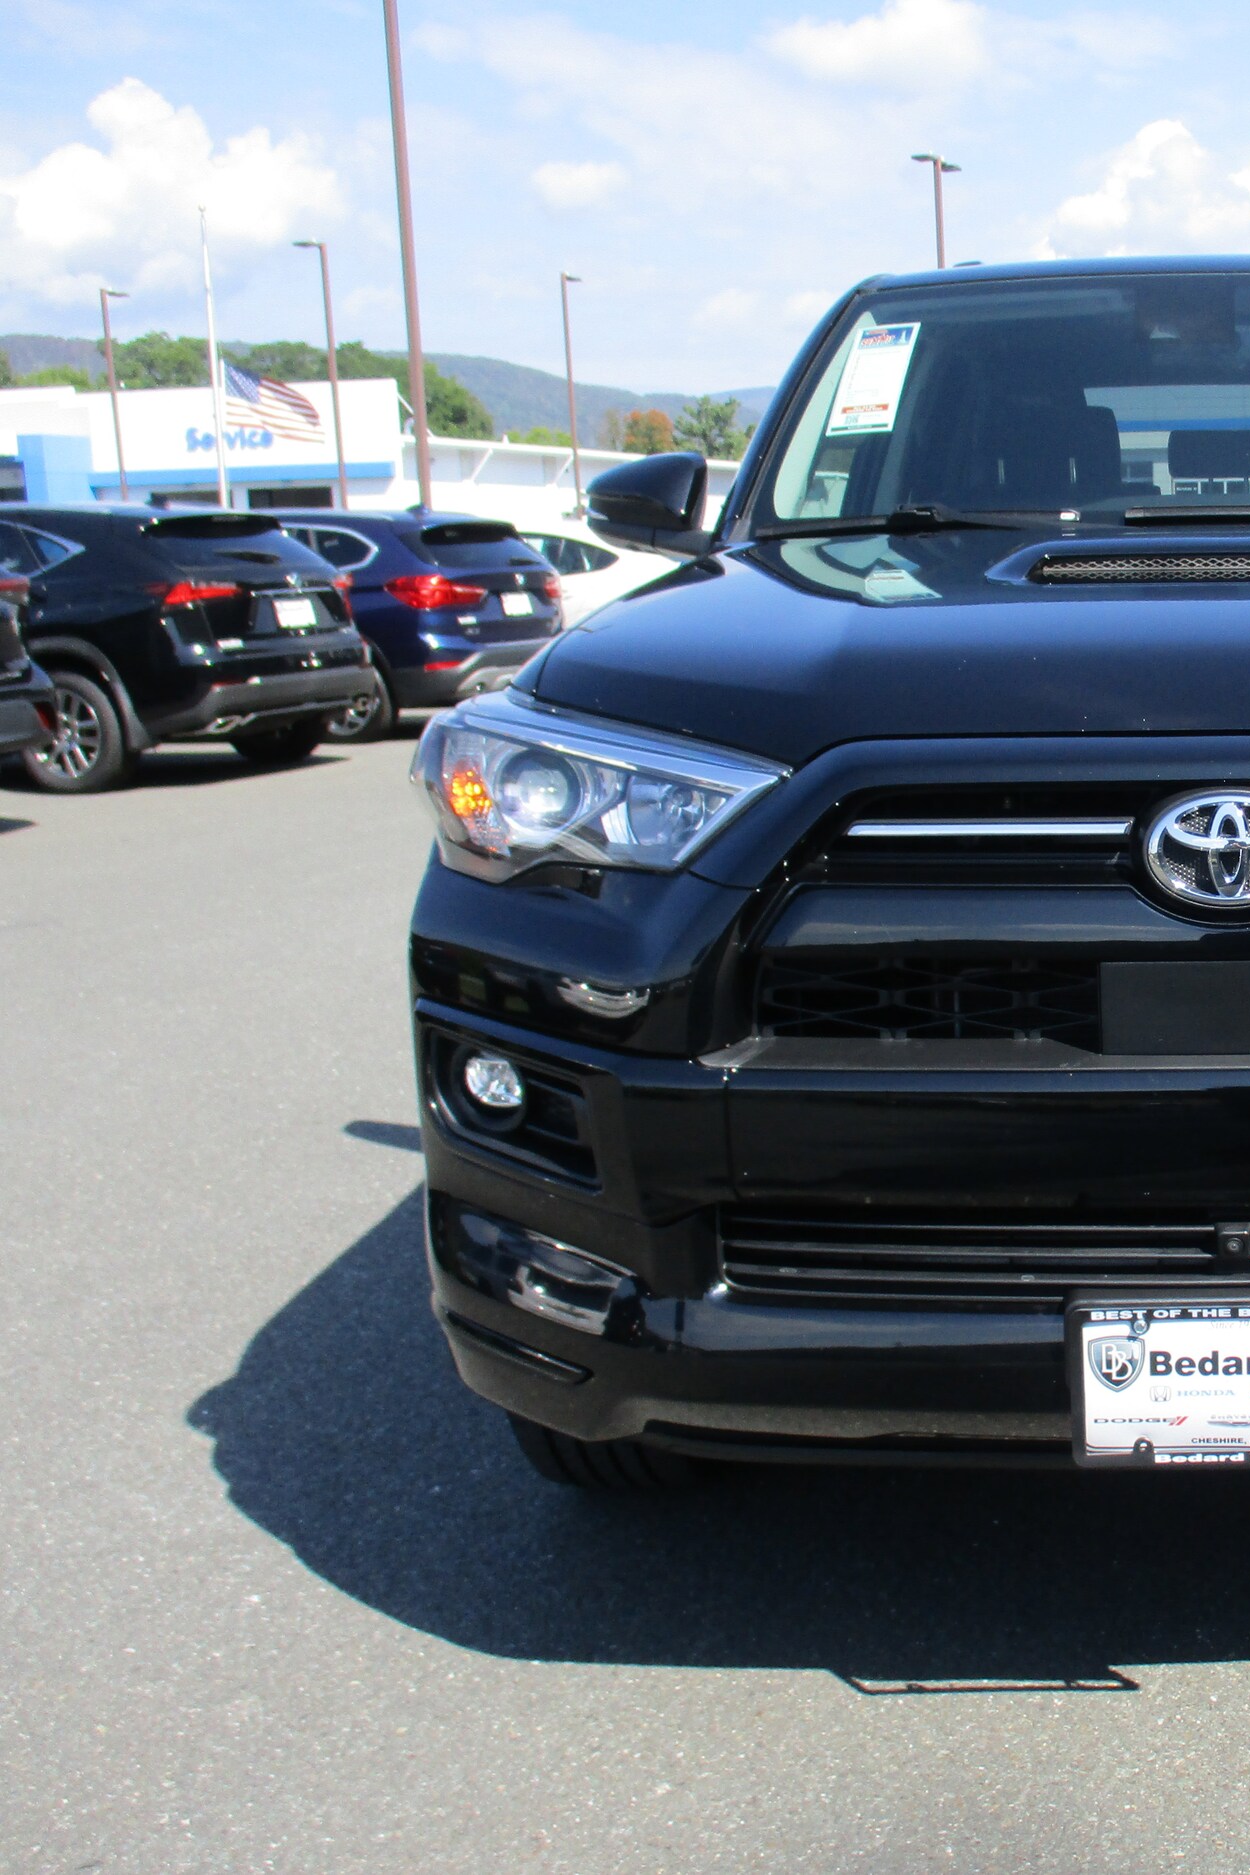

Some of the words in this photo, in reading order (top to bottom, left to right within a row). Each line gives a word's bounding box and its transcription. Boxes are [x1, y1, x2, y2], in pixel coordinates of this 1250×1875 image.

[1090, 1310, 1147, 1320] BEST
[1153, 1309, 1181, 1318] OF
[1187, 1308, 1231, 1318] THE
[1177, 1389, 1236, 1397] HONDA
[1154, 1452, 1244, 1463] Bedard
